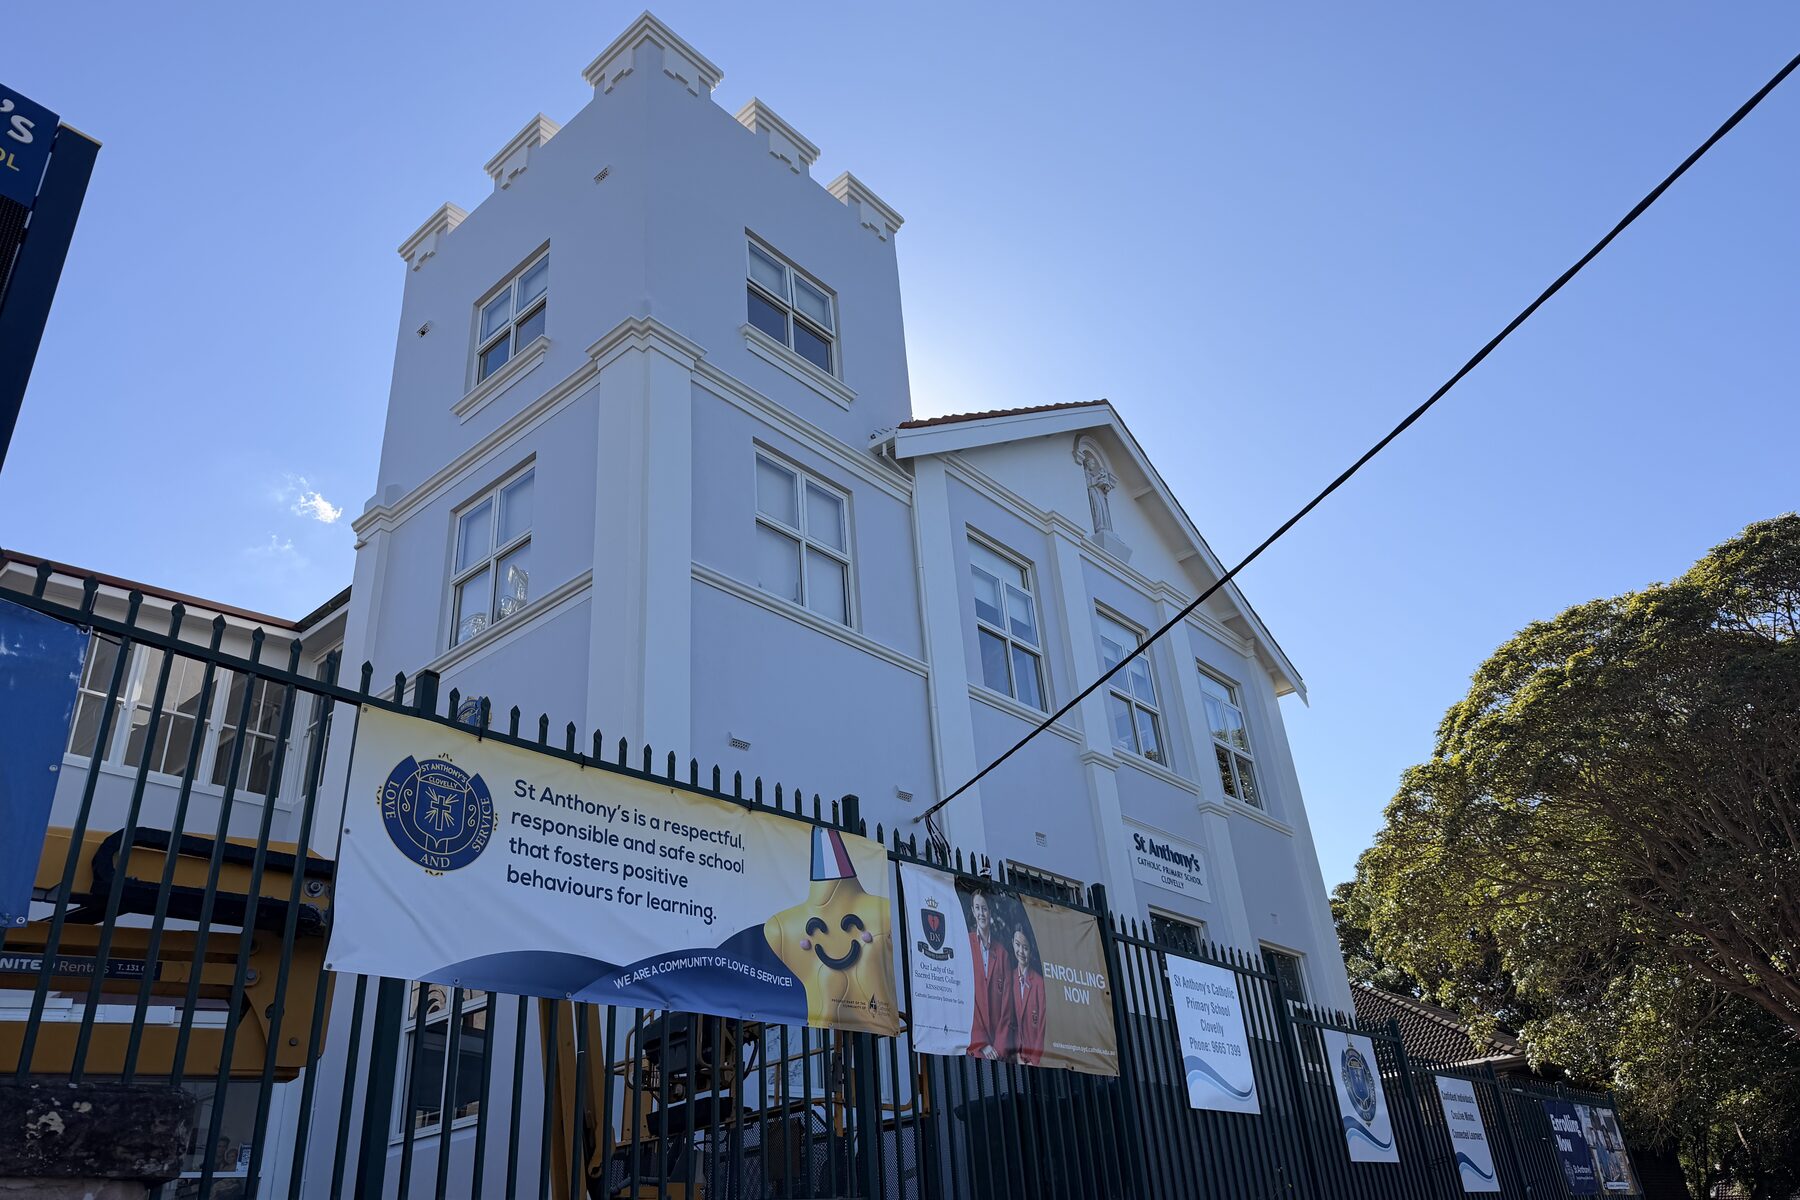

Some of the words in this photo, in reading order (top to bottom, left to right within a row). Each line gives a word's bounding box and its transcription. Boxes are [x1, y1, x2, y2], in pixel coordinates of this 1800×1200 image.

[421, 763, 430, 772] ST
[431, 763, 468, 783] ANTHONY'S
[428, 776, 458, 789] CLOVELLY
[384, 780, 399, 819] LOVE
[472, 797, 492, 852] SERVICE
[514, 779, 536, 801] St
[540, 786, 630, 823] Anthony's
[634, 809, 647, 827] is
[650, 816, 660, 829] a
[664, 819, 745, 851] respectful,
[511, 810, 619, 847] responsible
[623, 838, 655, 855] and
[659, 842, 695, 863] safe
[698, 852, 744, 874] school
[1133, 833, 1147, 853] St
[1149, 838, 1200, 873] Anthony's
[420, 853, 450, 868] AND
[509, 837, 550, 861] that
[554, 845, 619, 875] fosters
[622, 861, 688, 888] positive
[1137, 857, 1161, 872] CATHOLIC
[1162, 865, 1183, 879] PRIMARY
[1184, 873, 1203, 886] SCHOOL
[507, 864, 613, 901] behaviours
[617, 886, 643, 906] for
[646, 891, 717, 925] learning.
[1161, 875, 1184, 889] CLOVELLY
[0, 957, 55, 971] NITE
[613, 974, 632, 989] WE
[632, 967, 652, 983] ARE
[651, 965, 659, 976] A
[658, 956, 713, 973] COMMUNITY
[714, 956, 727, 967] OF
[727, 959, 749, 975] LOVE
[750, 967, 756, 977] &
[1043, 961, 1105, 989] ENROLLING
[1064, 985, 1090, 1005] NOW
[1174, 974, 1181, 988] St
[1182, 976, 1211, 995] Anthony's
[1211, 983, 1235, 999] Catholic
[1186, 996, 1210, 1015] Primary
[1210, 1001, 1231, 1017] School
[1200, 1018, 1224, 1037] Clovelly
[1189, 1036, 1211, 1052] Phone:
[1550, 1113, 1582, 1138] Enrolling
[1556, 1134, 1573, 1152] Now
